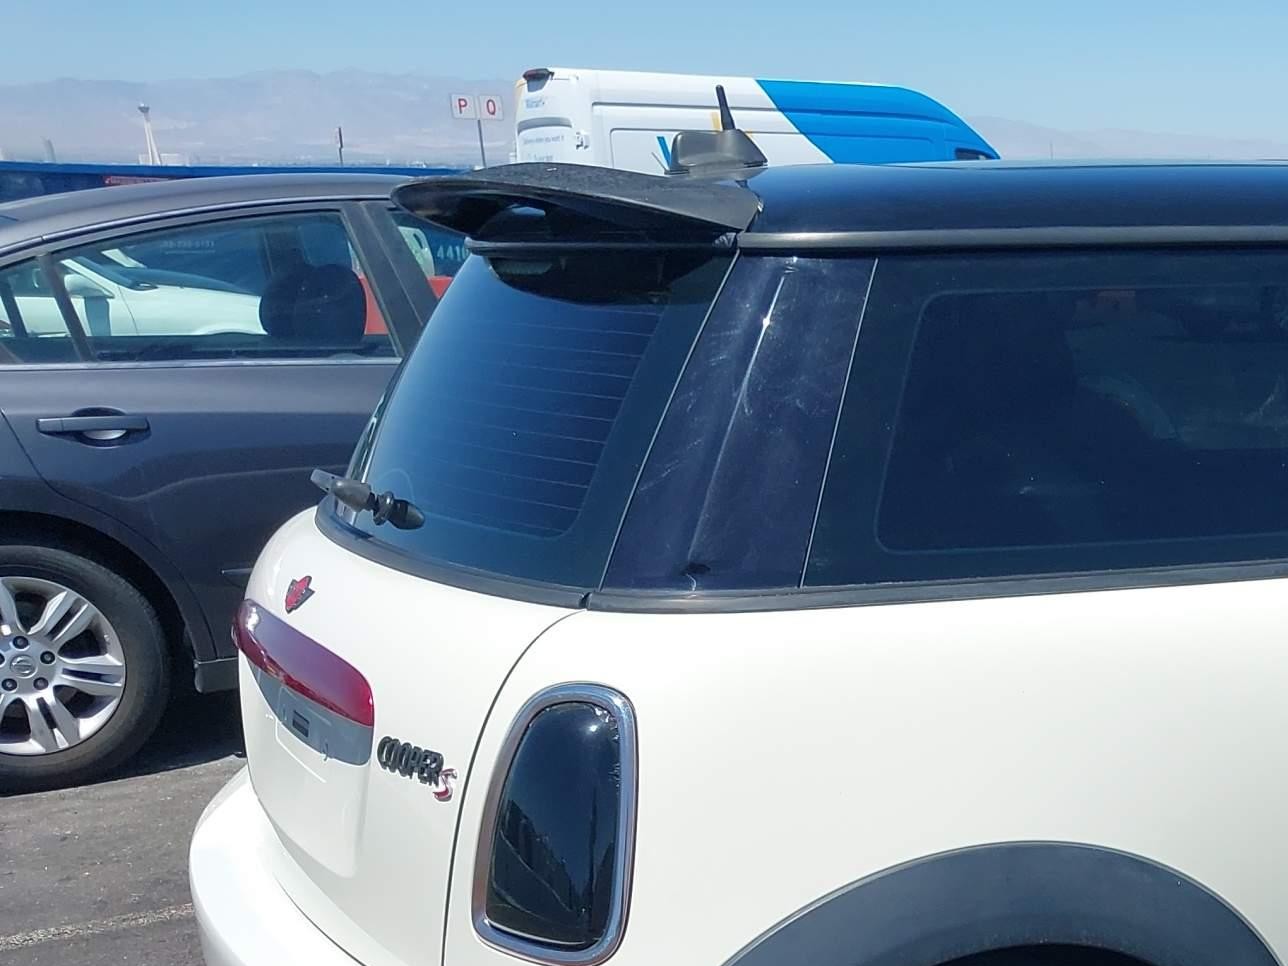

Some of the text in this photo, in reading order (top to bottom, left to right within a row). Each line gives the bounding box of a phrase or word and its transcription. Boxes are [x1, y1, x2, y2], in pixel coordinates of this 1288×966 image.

[458, 98, 468, 114] P
[377, 735, 458, 802] COOPER S
